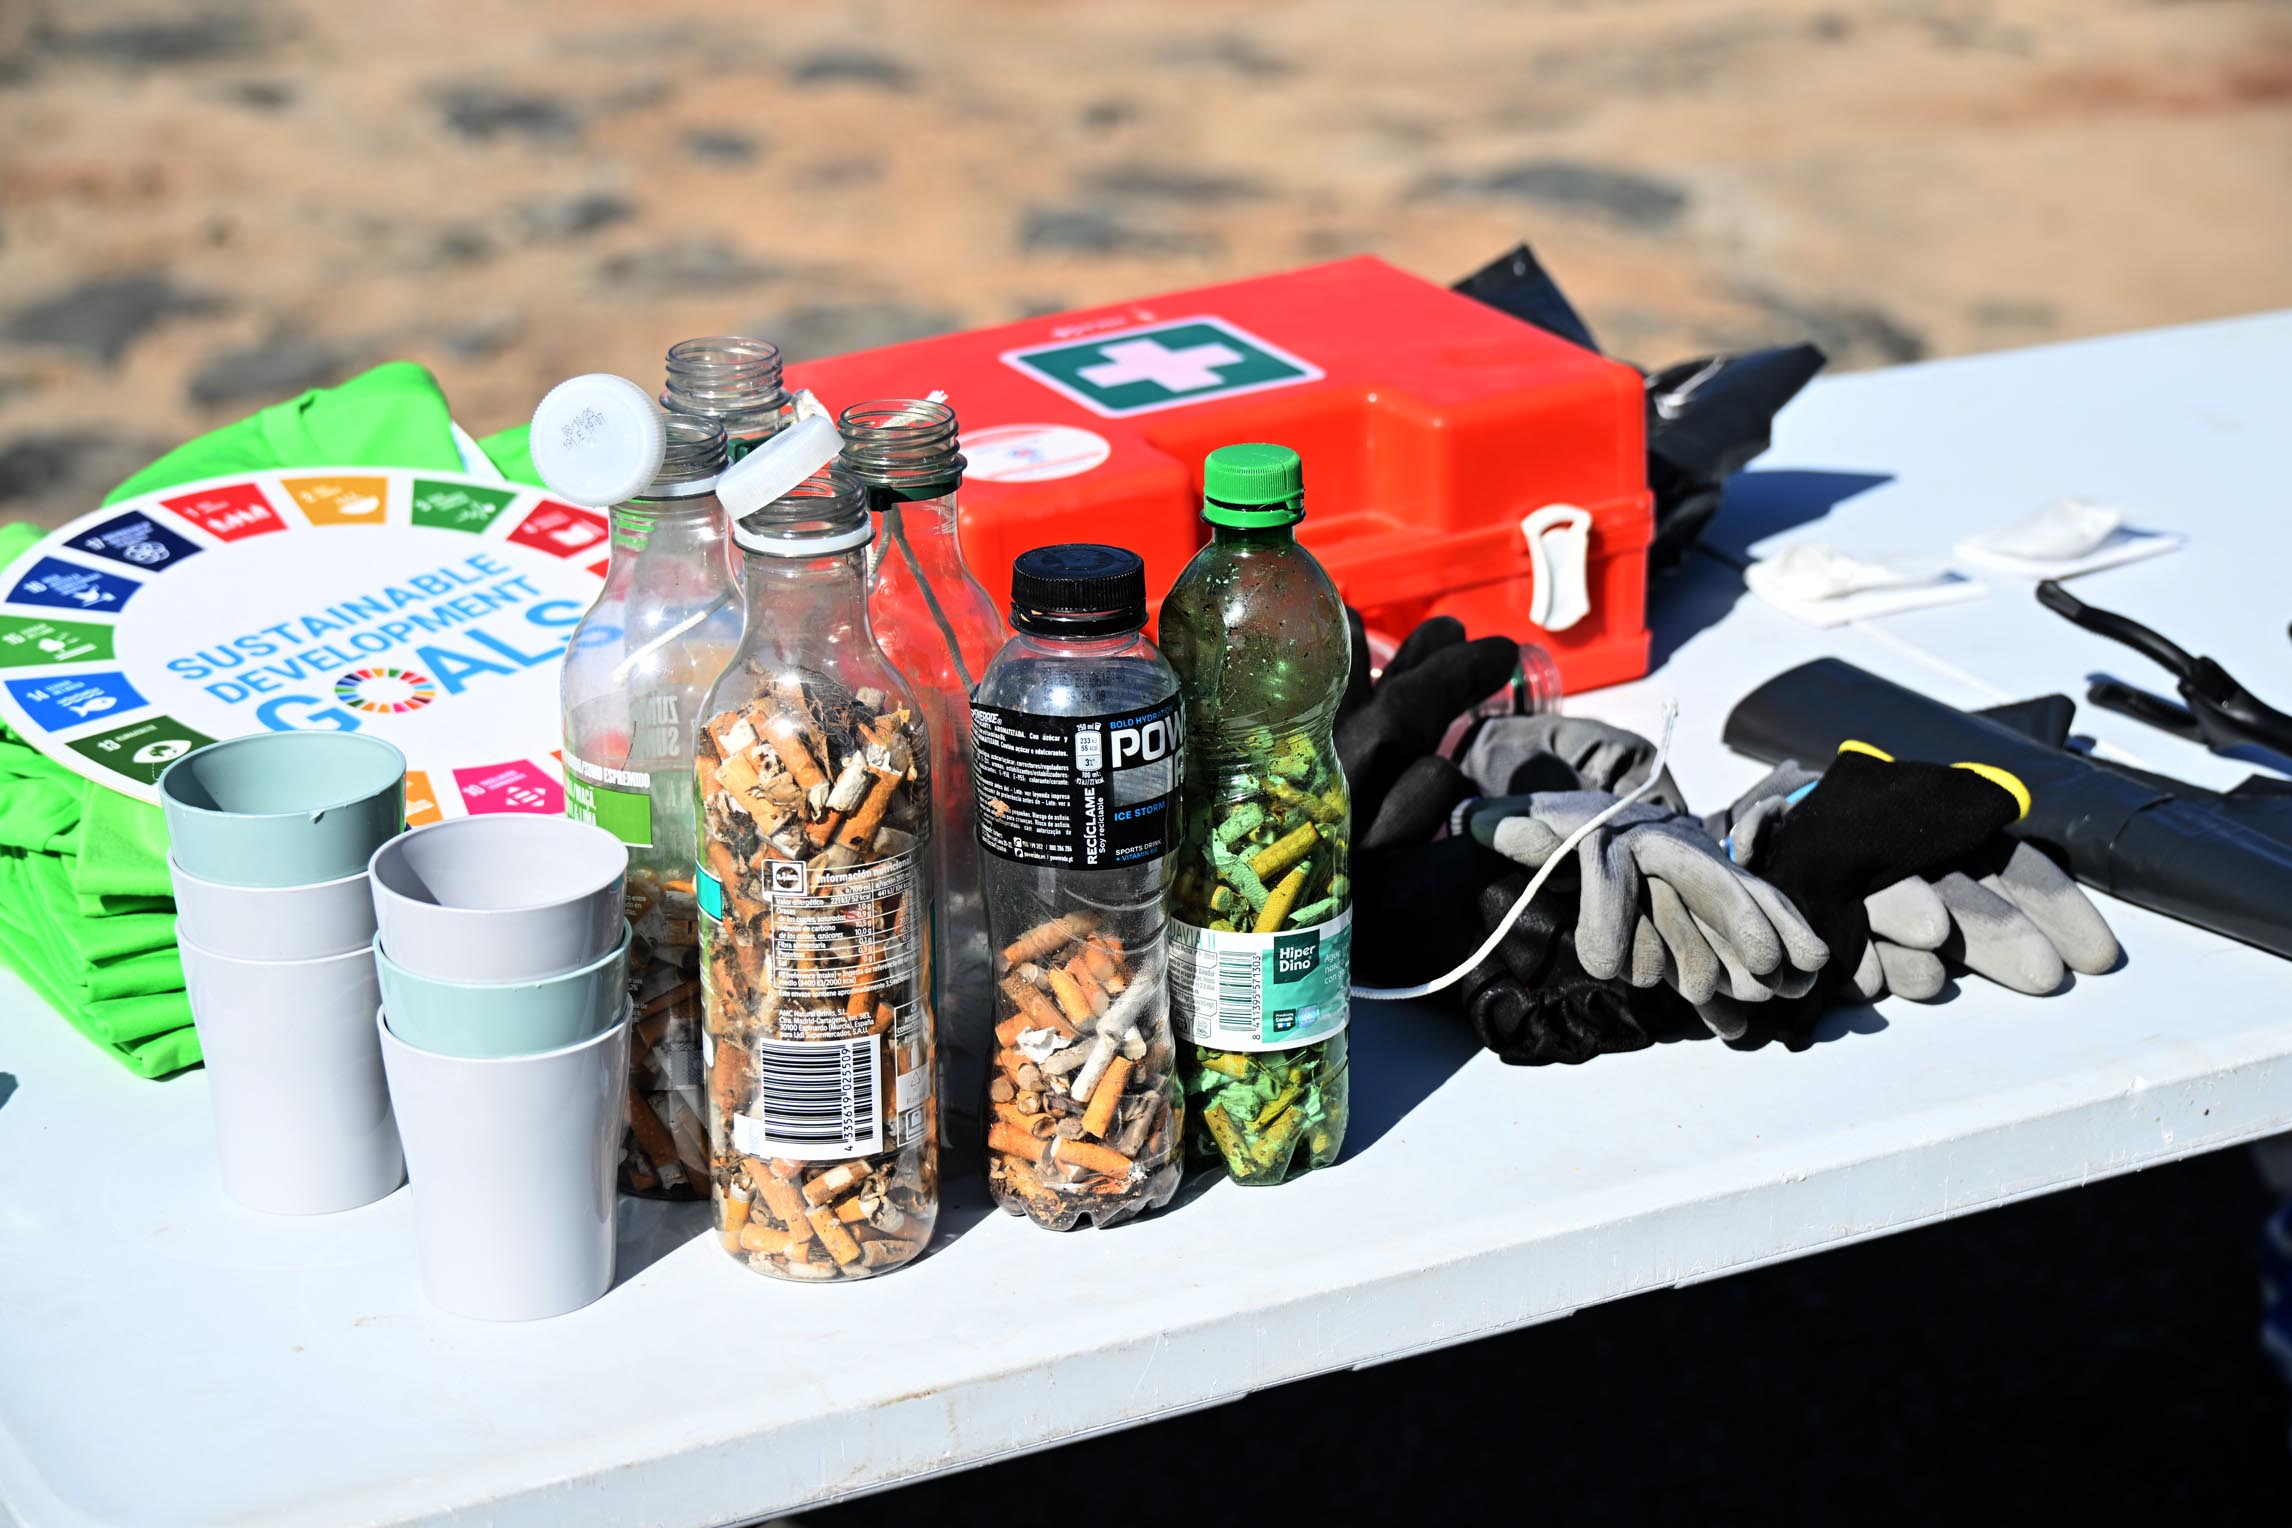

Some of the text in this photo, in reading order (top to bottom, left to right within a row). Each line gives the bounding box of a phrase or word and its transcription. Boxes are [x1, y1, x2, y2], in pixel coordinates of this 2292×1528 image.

[166, 553, 510, 680] SUSTAINABLE
[204, 574, 541, 704] DEVELOPMENT
[1110, 718, 1134, 729] BOLD
[1111, 705, 1185, 768] POW
[1114, 801, 1165, 821] ICE STORM
[1098, 840, 1106, 854] Soy
[1115, 839, 1161, 856] SPORTS DRINK
[816, 871, 872, 884] Información
[1280, 945, 1316, 960] Hiper
[1280, 959, 1311, 972] Dino
[1325, 975, 1337, 984] con
[854, 1019, 874, 1028] España
